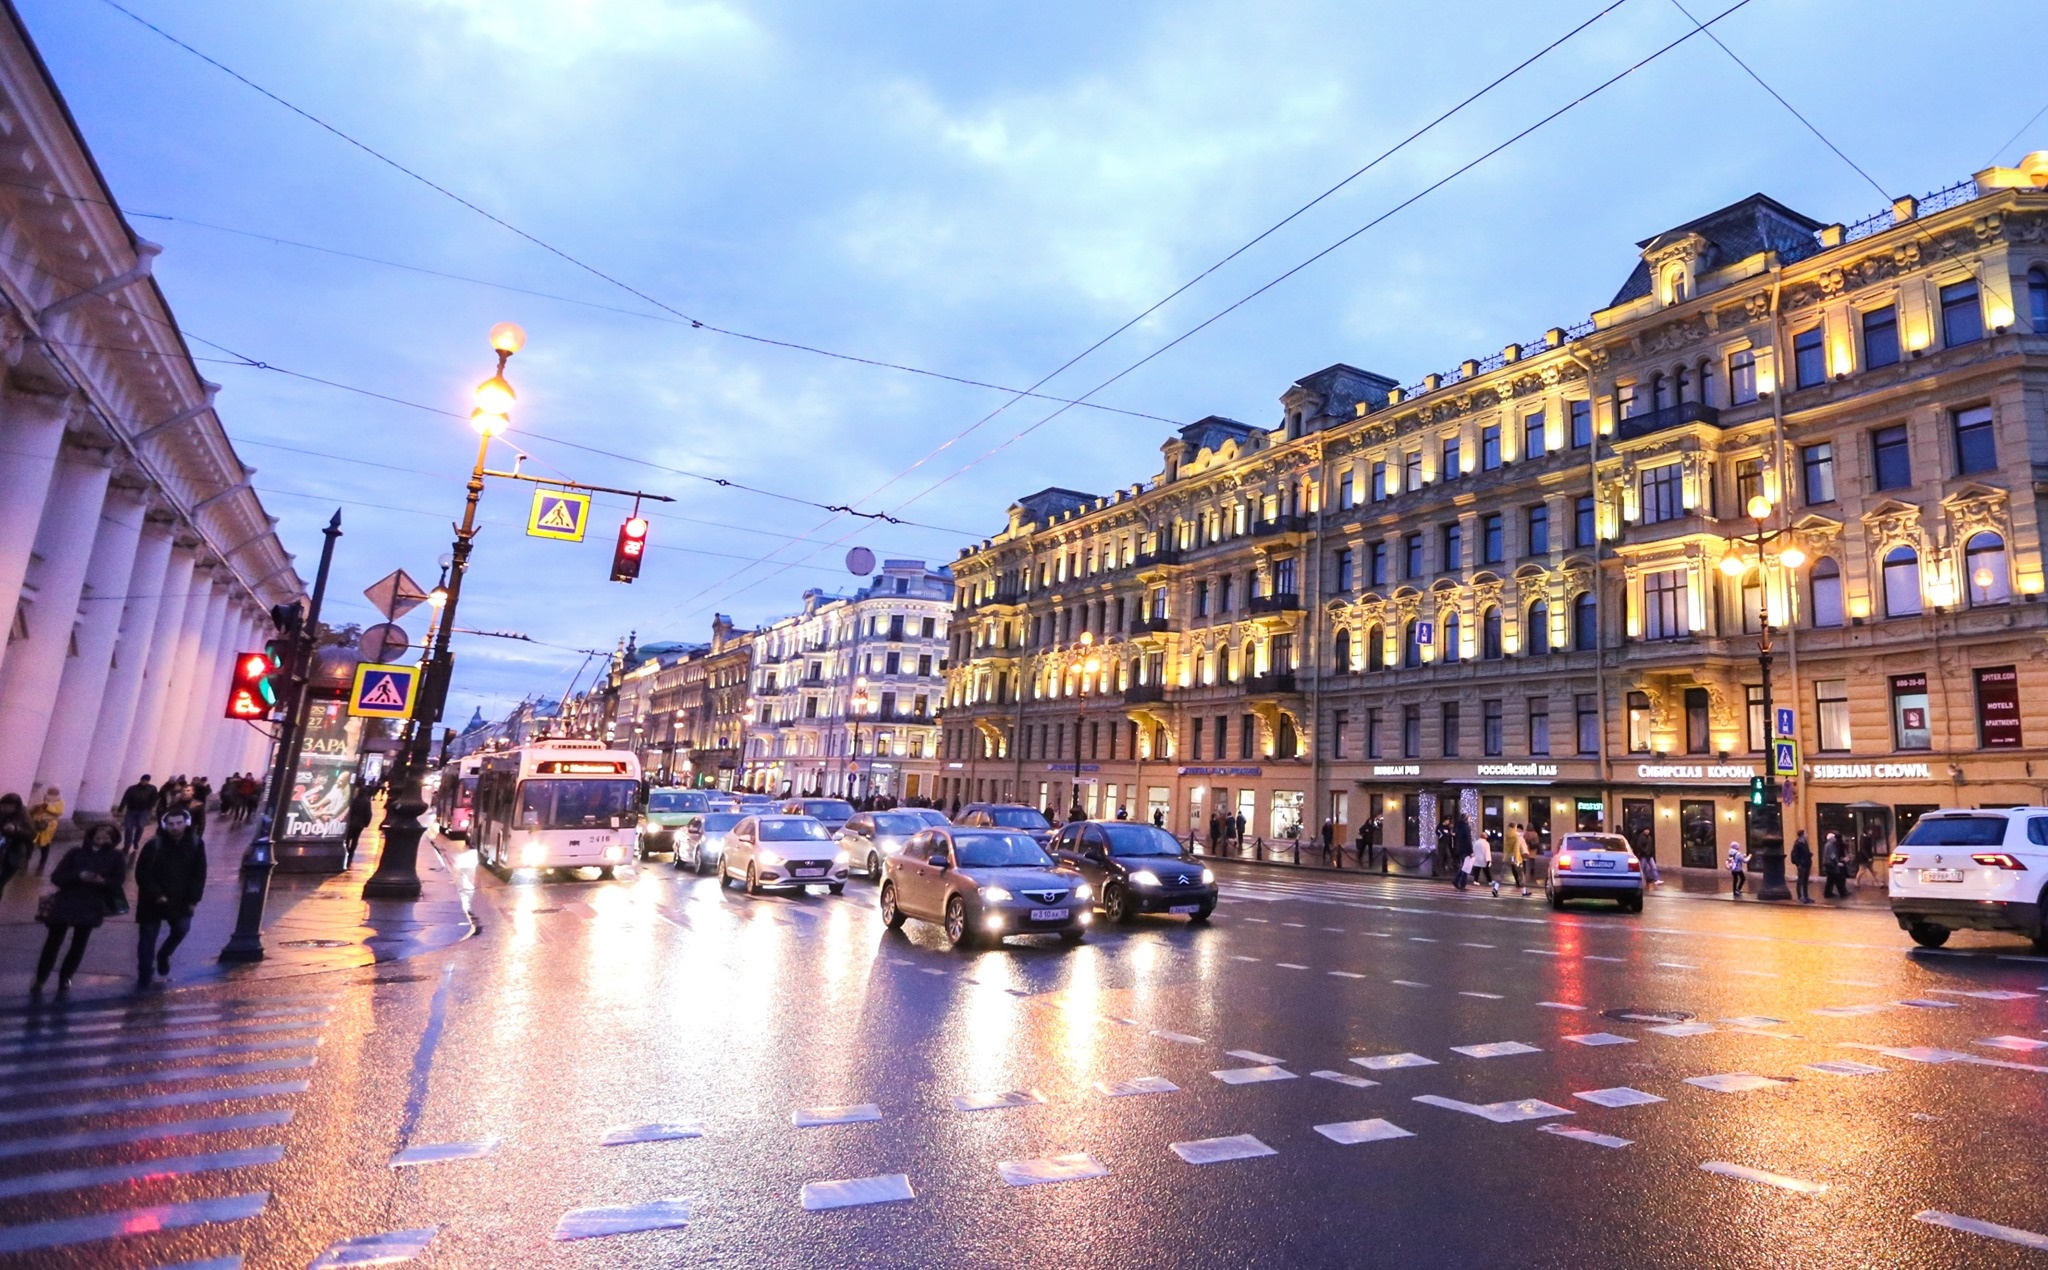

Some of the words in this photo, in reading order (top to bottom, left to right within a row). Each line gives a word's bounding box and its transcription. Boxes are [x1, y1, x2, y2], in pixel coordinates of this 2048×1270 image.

[1987, 702, 2014, 710] HOTELS
[1985, 719, 2019, 727] APARTMENTS
[302, 737, 348, 752] ЗАРА
[1374, 765, 1404, 776] RUSSIAN
[1405, 765, 1420, 776] PUB
[1478, 763, 1537, 776] РОССИЙСКИЙ
[1538, 765, 1557, 776] ПАБ
[1638, 764, 1702, 777] СИБИРСКАЯ
[1707, 765, 1755, 777] КОРОНА
[1813, 764, 1872, 779] SIBERIAN
